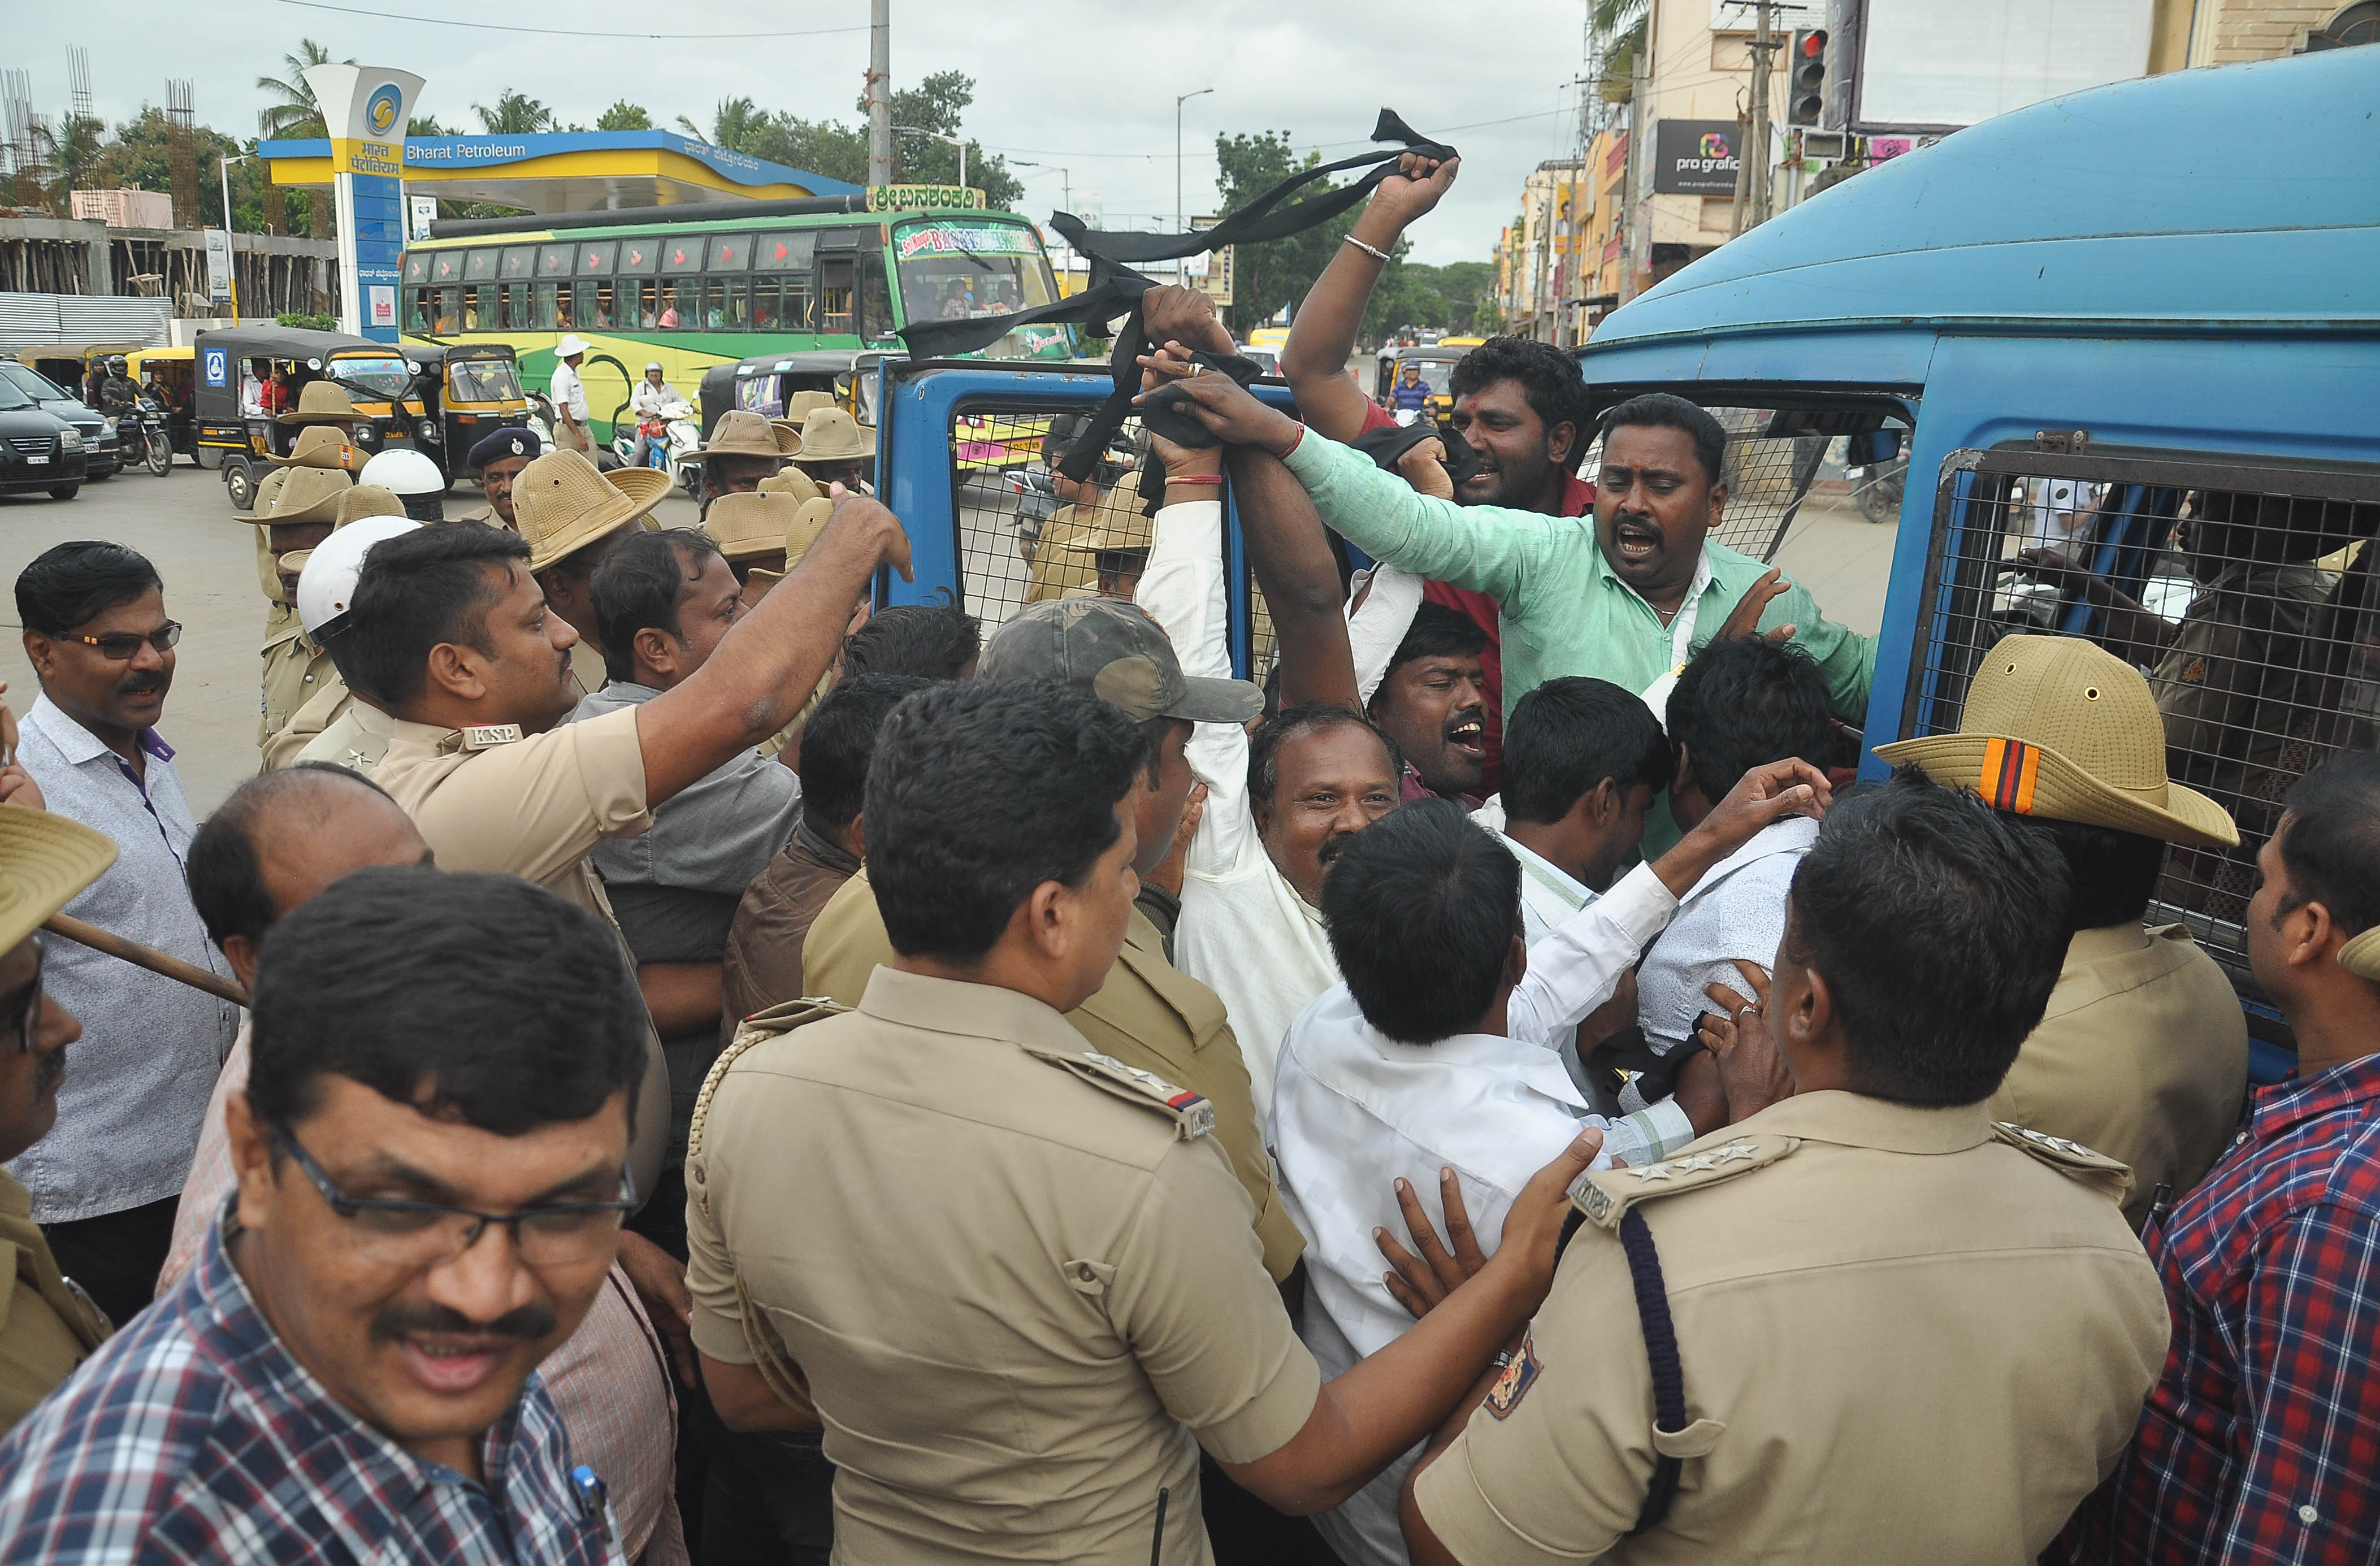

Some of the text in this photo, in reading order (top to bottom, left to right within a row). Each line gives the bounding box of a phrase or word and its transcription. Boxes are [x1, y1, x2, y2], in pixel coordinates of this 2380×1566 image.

[362, 143, 389, 157] भारत
[406, 143, 526, 160] Bharat Petroleum
[1676, 158, 1700, 172] pro
[876, 185, 897, 210] ಶ್ರೀ
